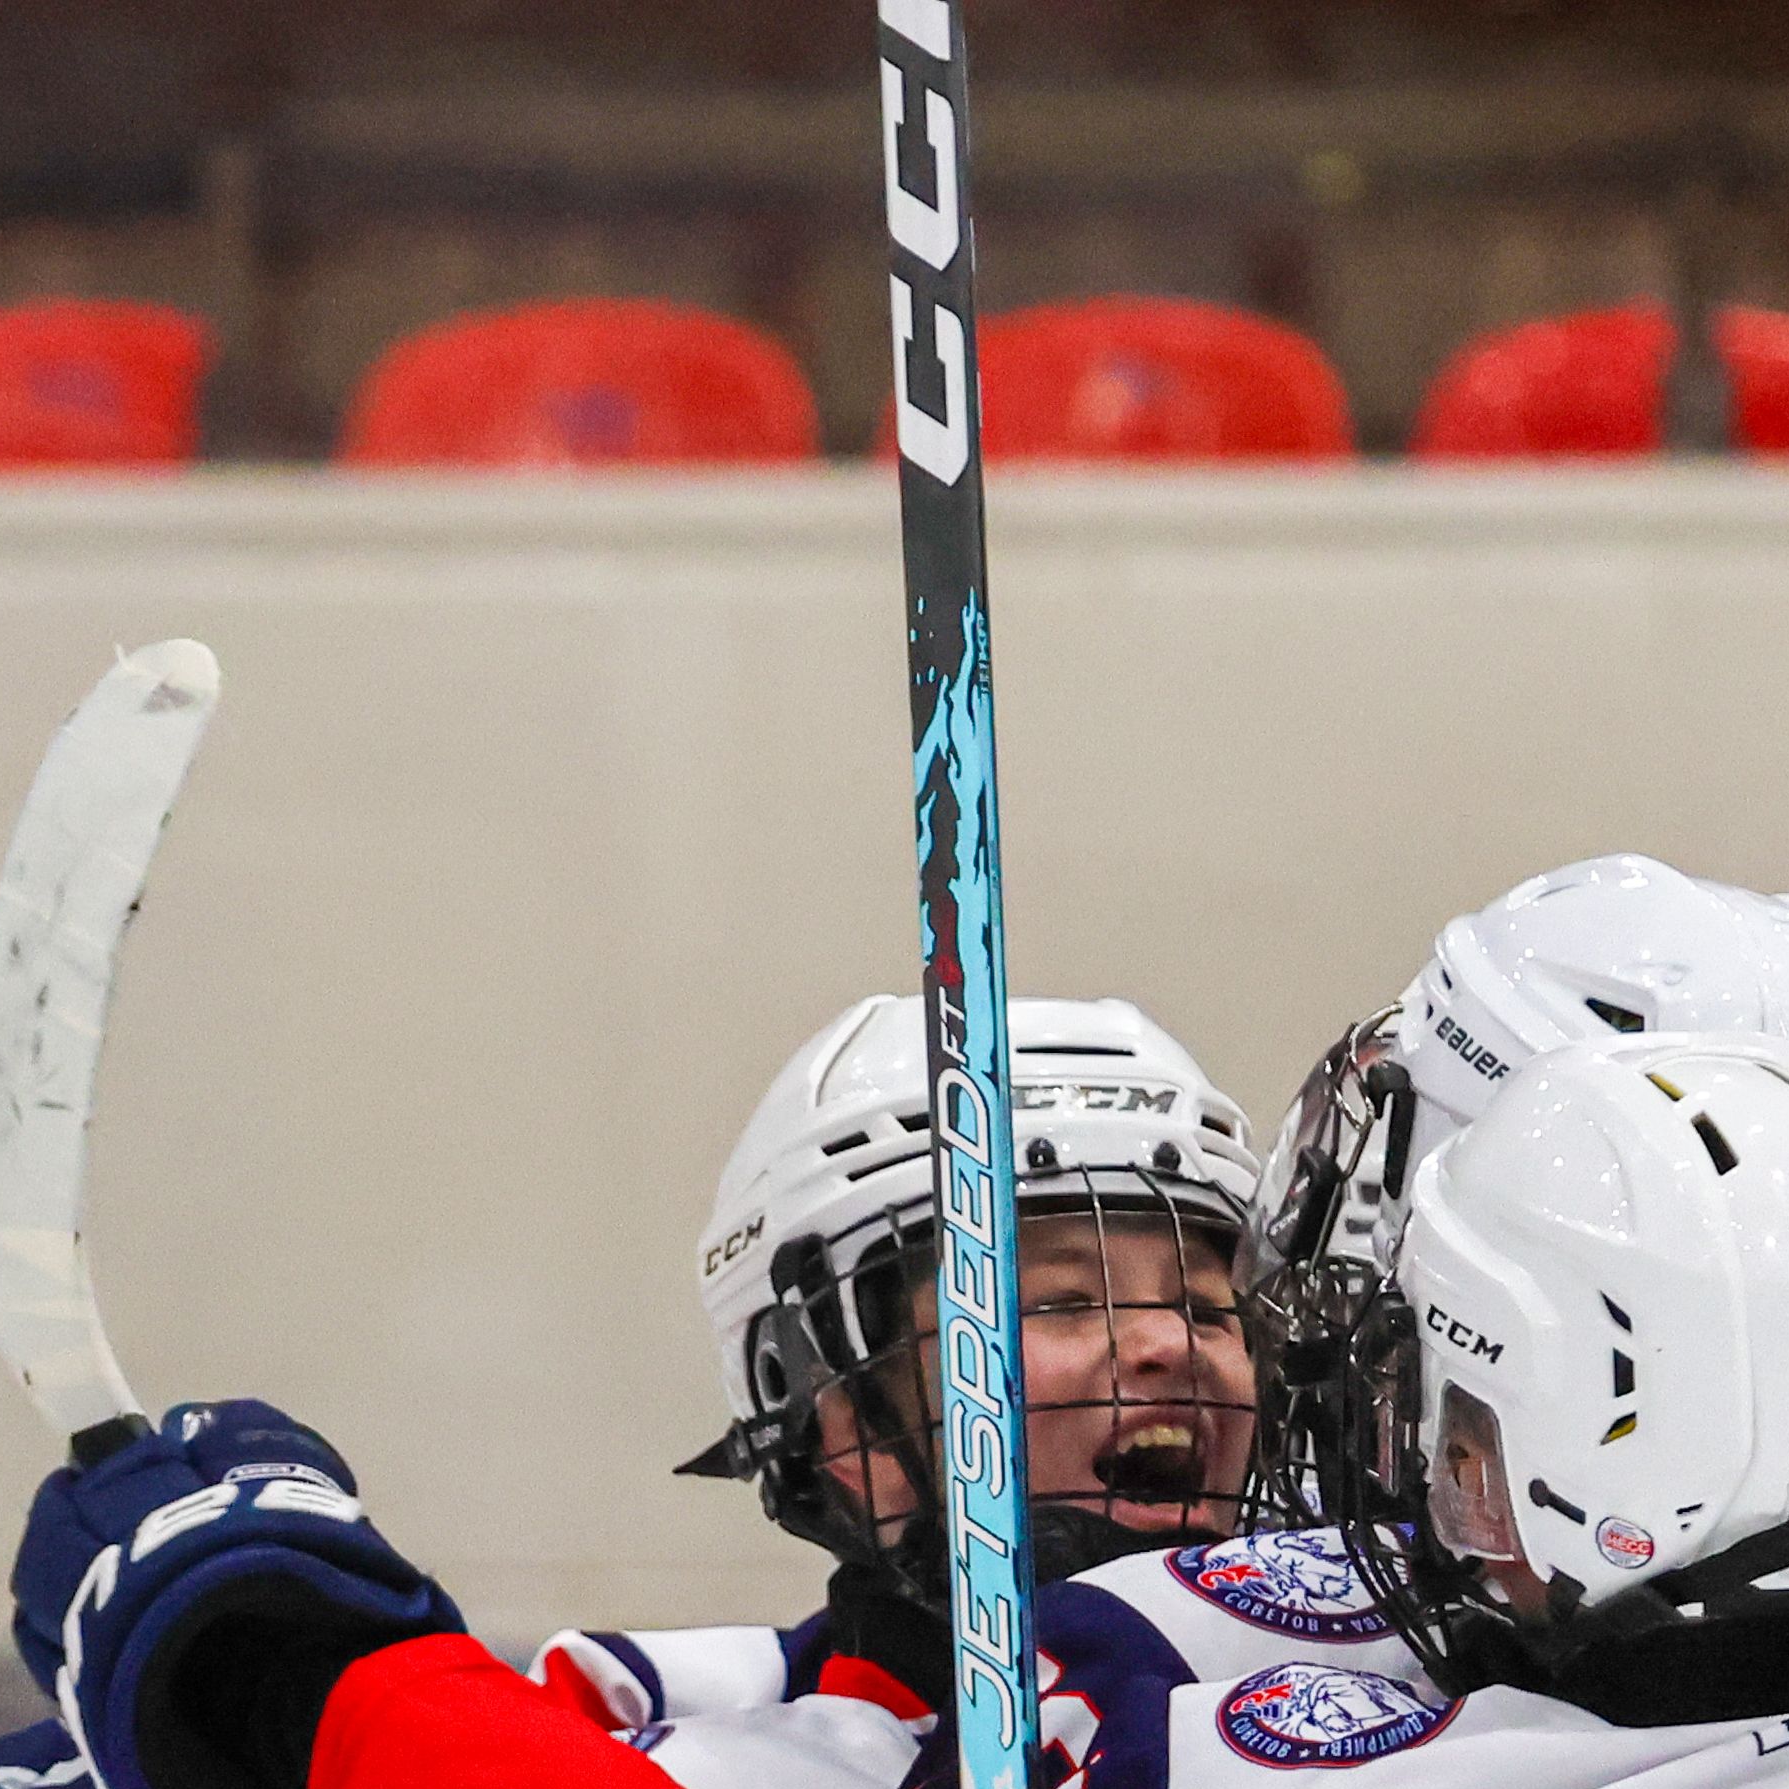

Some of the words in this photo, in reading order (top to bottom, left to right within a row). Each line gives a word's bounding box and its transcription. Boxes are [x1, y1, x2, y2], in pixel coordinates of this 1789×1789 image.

[937, 987, 968, 1067] FT
[1011, 1085, 1180, 1114] CCM
[704, 1212, 765, 1277] CCM
[1426, 1303, 1504, 1364] CCM
[935, 1068, 1016, 1752] JETSPEED
